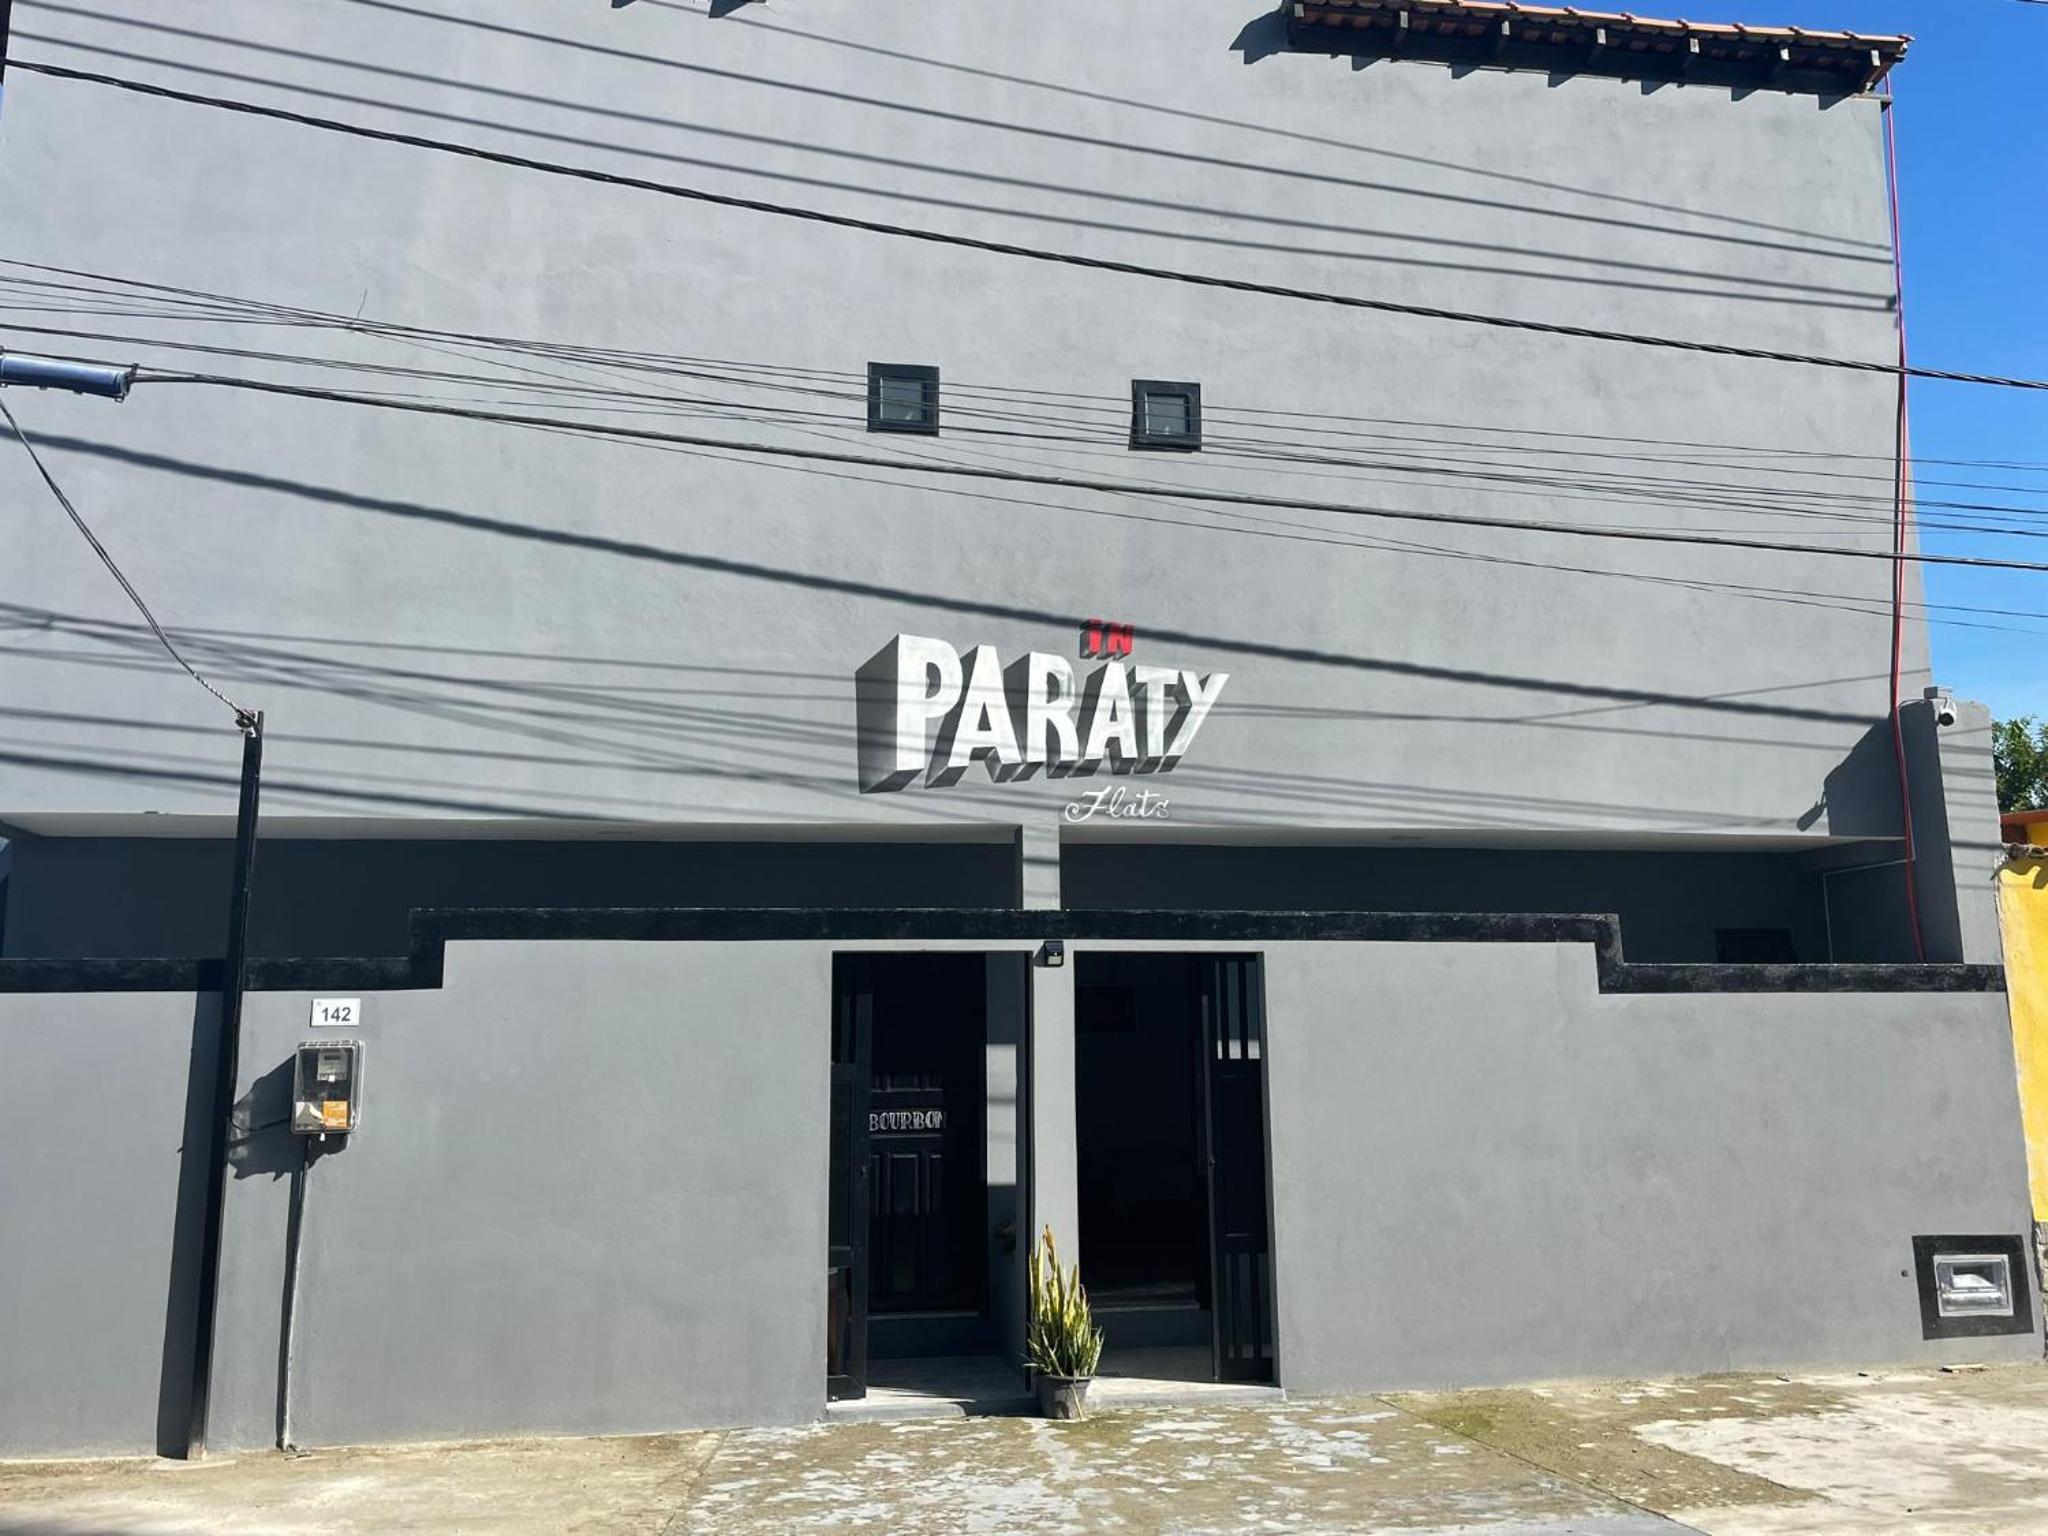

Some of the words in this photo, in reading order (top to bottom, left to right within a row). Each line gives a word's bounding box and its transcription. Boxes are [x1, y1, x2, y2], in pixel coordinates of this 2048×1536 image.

[1080, 618, 1135, 659] IN
[857, 633, 1230, 792] PARATY
[1064, 786, 1171, 823] Flats
[321, 1006, 352, 1022] 142
[869, 1110, 946, 1132] BOURBON
